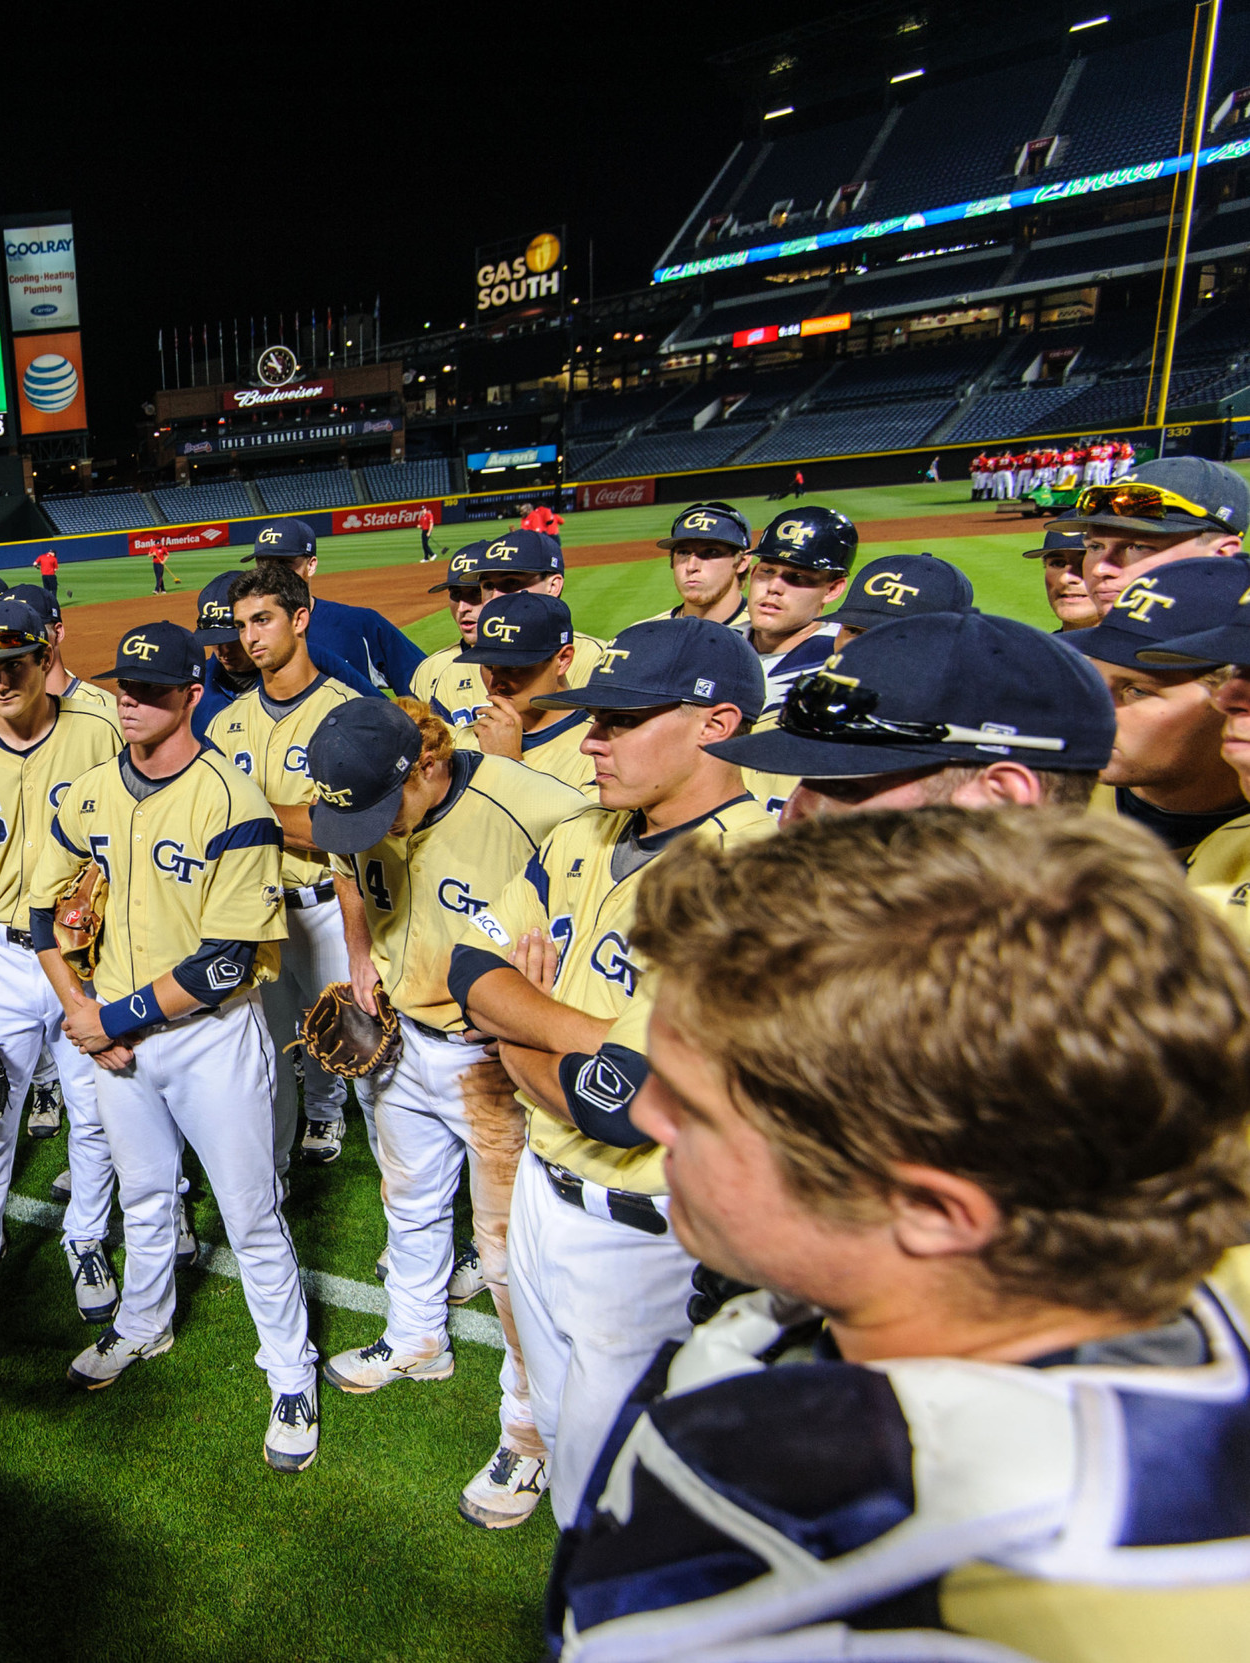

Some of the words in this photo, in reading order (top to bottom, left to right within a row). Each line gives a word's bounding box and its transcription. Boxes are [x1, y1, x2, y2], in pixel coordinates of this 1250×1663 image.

[6, 239, 72, 256] COOLRAY
[9, 273, 39, 284] Cooling
[43, 270, 74, 281] Heating
[477, 257, 526, 287] GAS
[23, 284, 62, 295] Plumbing
[477, 271, 559, 310] SOUTH
[233, 385, 323, 408] Budweiser
[221, 438, 245, 449] THIS
[251, 436, 262, 445] IS
[267, 429, 304, 443] BRAVES
[309, 425, 353, 440] COUNTRY
[1166, 427, 1191, 438] 330
[363, 511, 396, 527] State
[683, 512, 718, 533] GT
[134, 538, 155, 549] Bank
[166, 535, 200, 546] America
[258, 528, 282, 544] GT
[776, 518, 815, 546] GT
[485, 541, 518, 561] GT
[864, 572, 919, 606] GT
[1115, 577, 1176, 622] GT
[483, 616, 520, 643] GT
[122, 634, 159, 661] GT
[314, 781, 352, 808] GT
[89, 834, 112, 886] 5
[152, 839, 205, 885] GT
[475, 914, 503, 939] ACC
